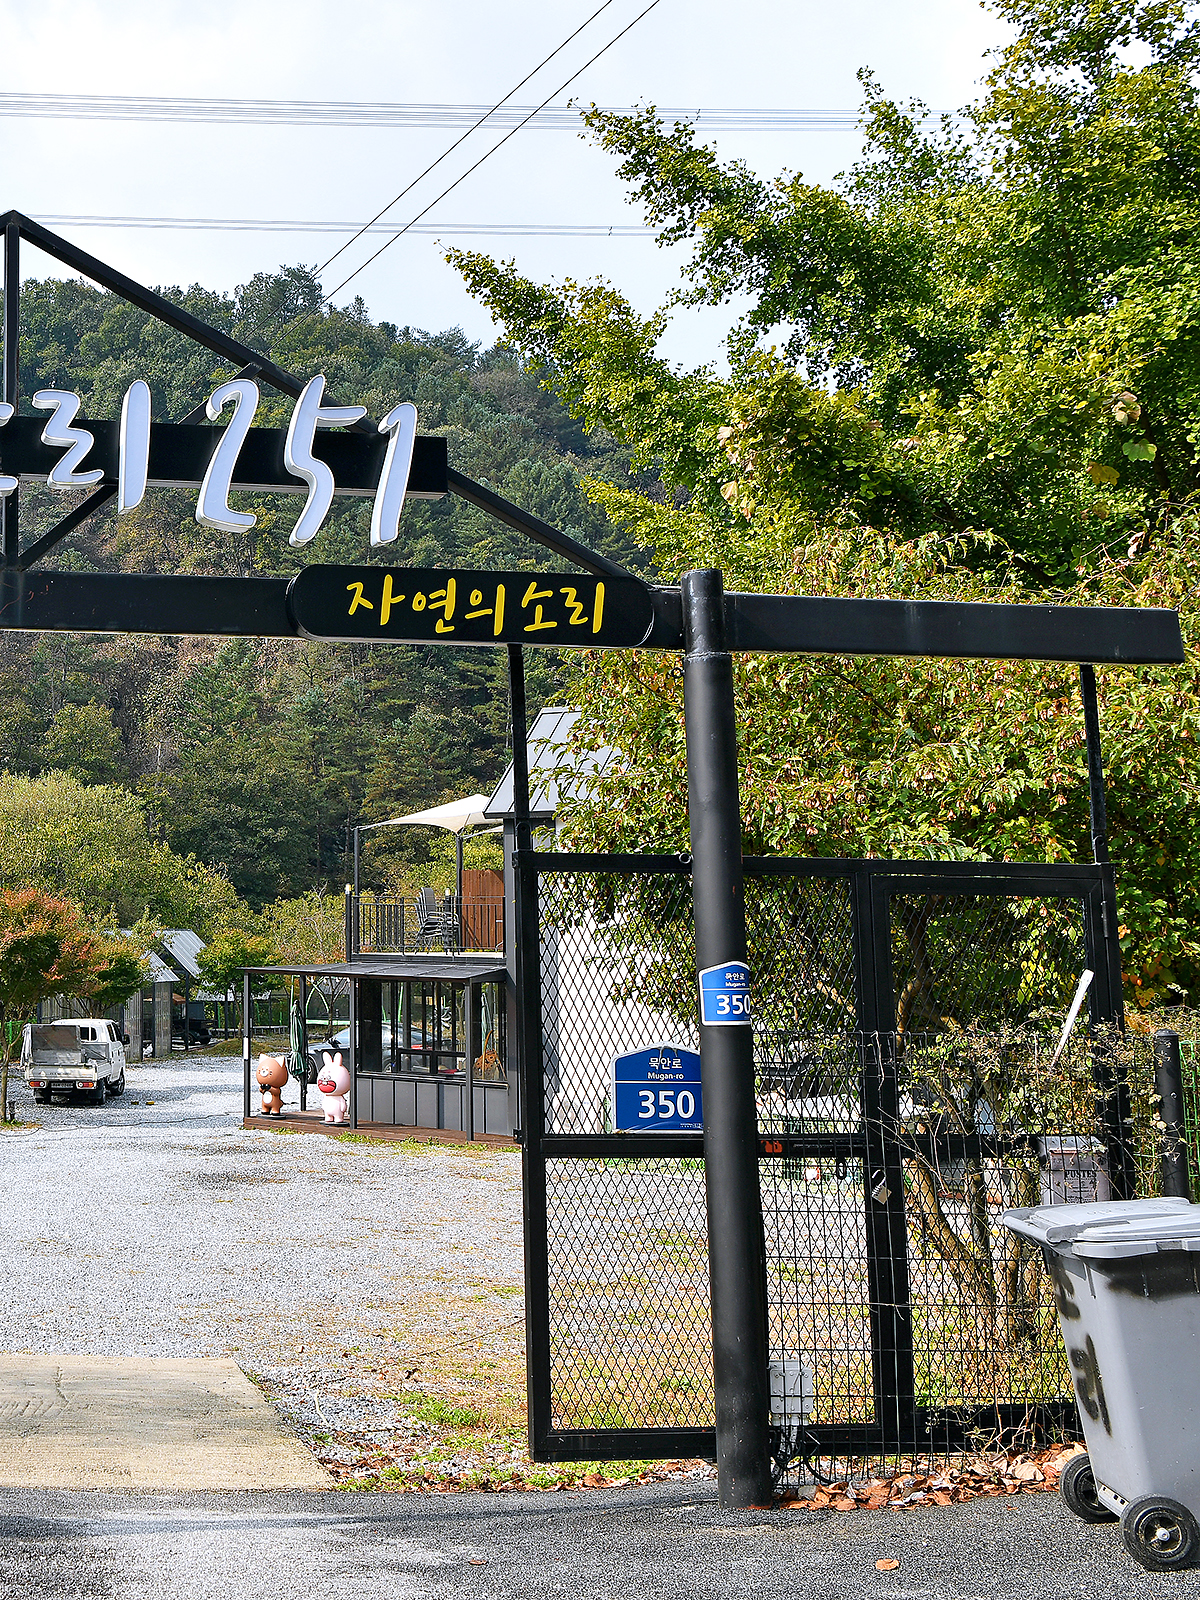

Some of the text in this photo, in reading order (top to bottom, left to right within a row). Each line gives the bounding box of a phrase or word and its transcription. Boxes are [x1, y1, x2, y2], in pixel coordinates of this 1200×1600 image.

[346, 574, 605, 636] 자연의 소리
[716, 994, 750, 1015] 350
[648, 1057, 683, 1070] 묵안로
[647, 1071, 685, 1081] Mugan-ro
[638, 1090, 695, 1118] 350
